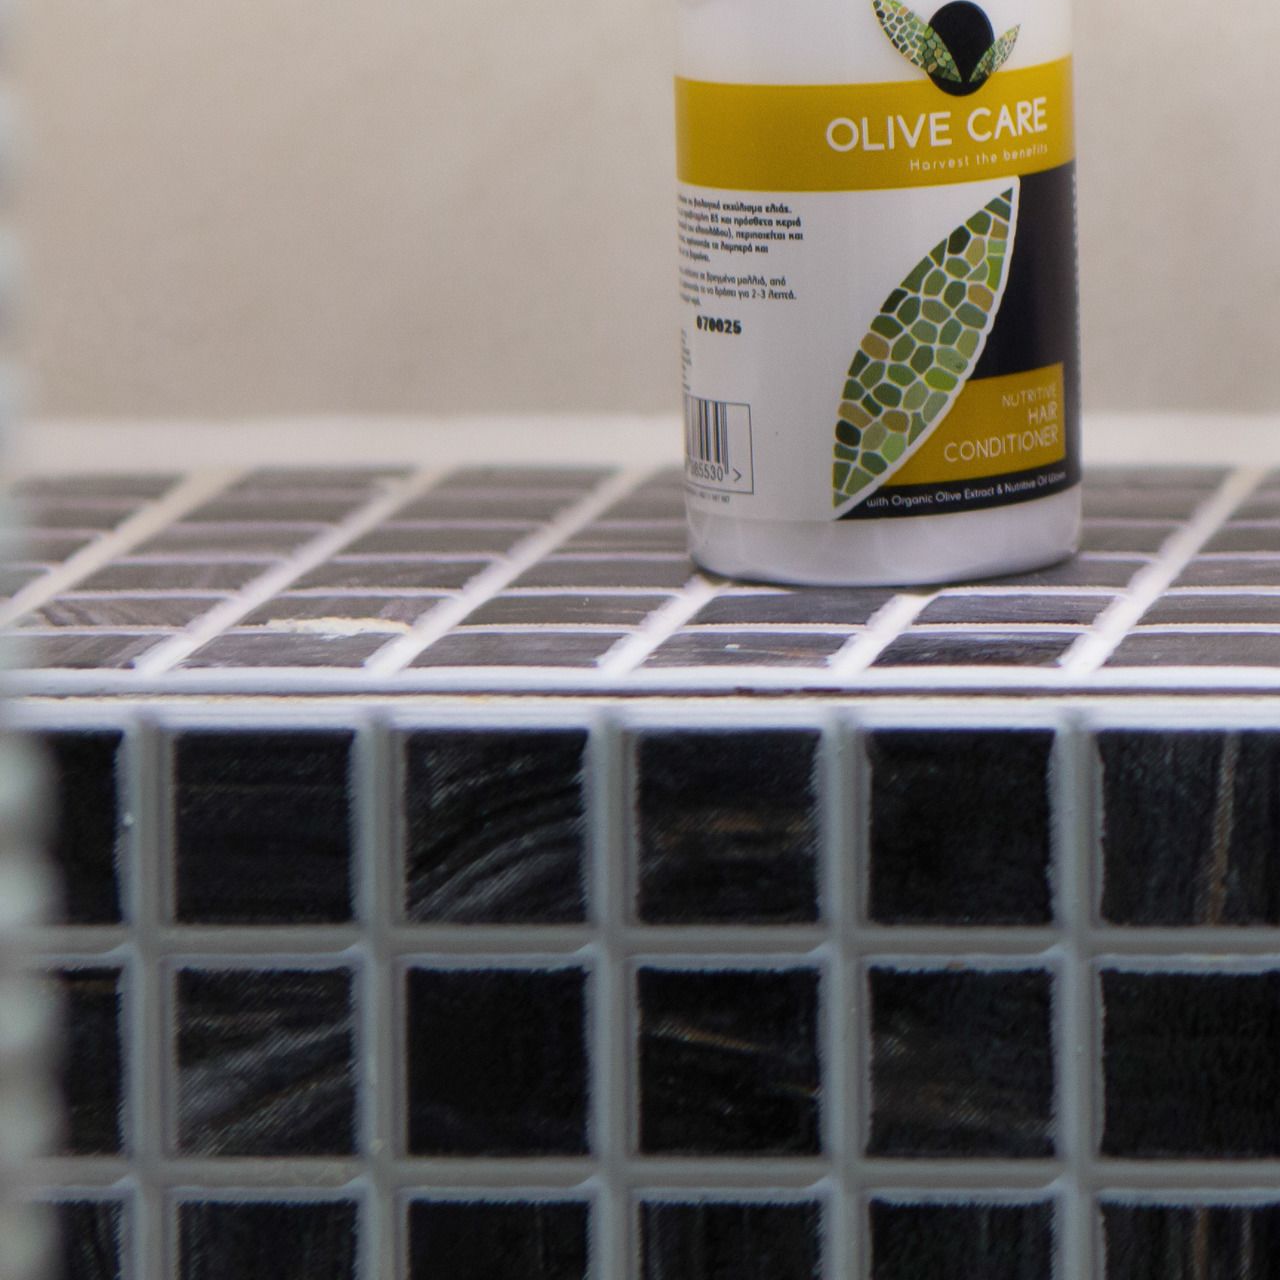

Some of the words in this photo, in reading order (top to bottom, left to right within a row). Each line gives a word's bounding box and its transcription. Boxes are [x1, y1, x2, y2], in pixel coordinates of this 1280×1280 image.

[826, 111, 952, 152] OLIVE
[967, 97, 1047, 142] CARE
[910, 154, 969, 171] Harvest
[976, 152, 997, 166] the
[1003, 144, 1047, 161] benefits
[1002, 384, 1056, 407] NUTRITIVE
[1028, 401, 1057, 424] HAIR
[944, 425, 1058, 463] CONDITIONER
[866, 496, 889, 508] with
[892, 494, 932, 508] Organic
[936, 491, 961, 503] Olive
[964, 488, 994, 500] Extract
